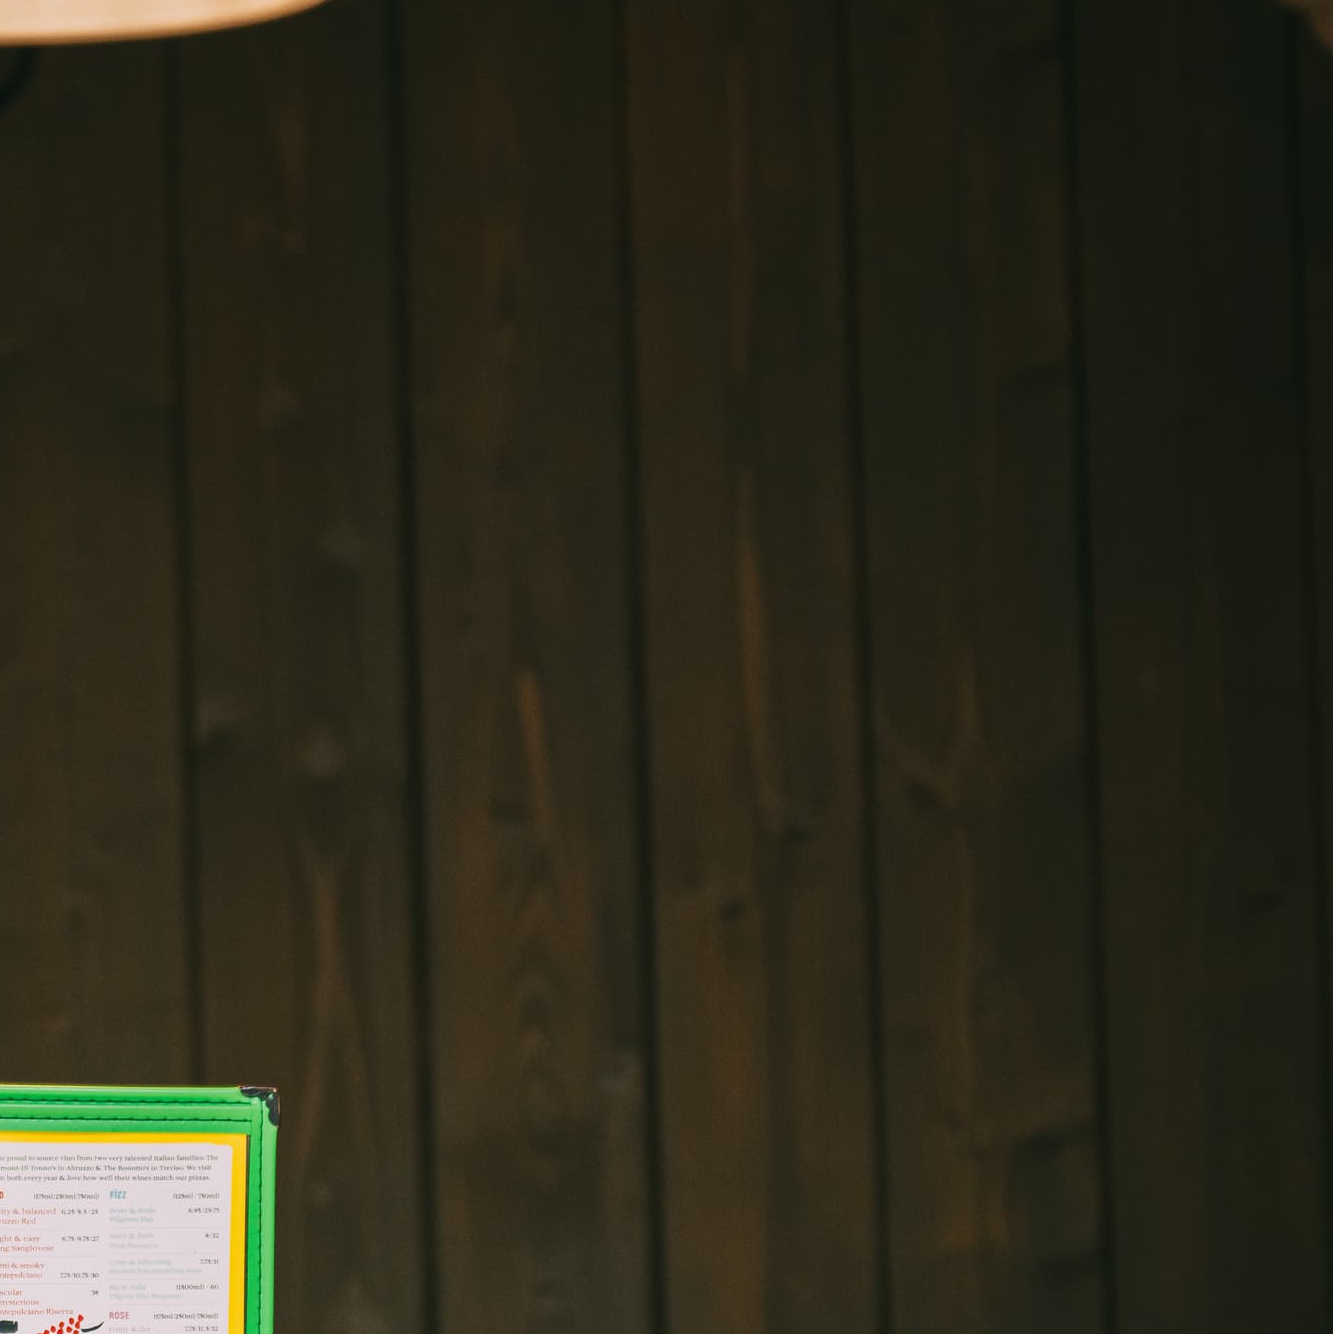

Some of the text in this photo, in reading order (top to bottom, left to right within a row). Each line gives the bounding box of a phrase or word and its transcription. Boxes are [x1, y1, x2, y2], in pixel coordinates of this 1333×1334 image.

[7, 1155, 27, 1163] proud
[189, 1175, 211, 1183] pizzas.
[12, 1208, 21, 1216] &
[22, 1207, 57, 1216] balanced
[13, 1235, 21, 1243] &
[11, 1245, 55, 1254] Sangiovese
[11, 1261, 19, 1269] &
[20, 1261, 45, 1270] smoky
[46, 1308, 73, 1316] Riserva
